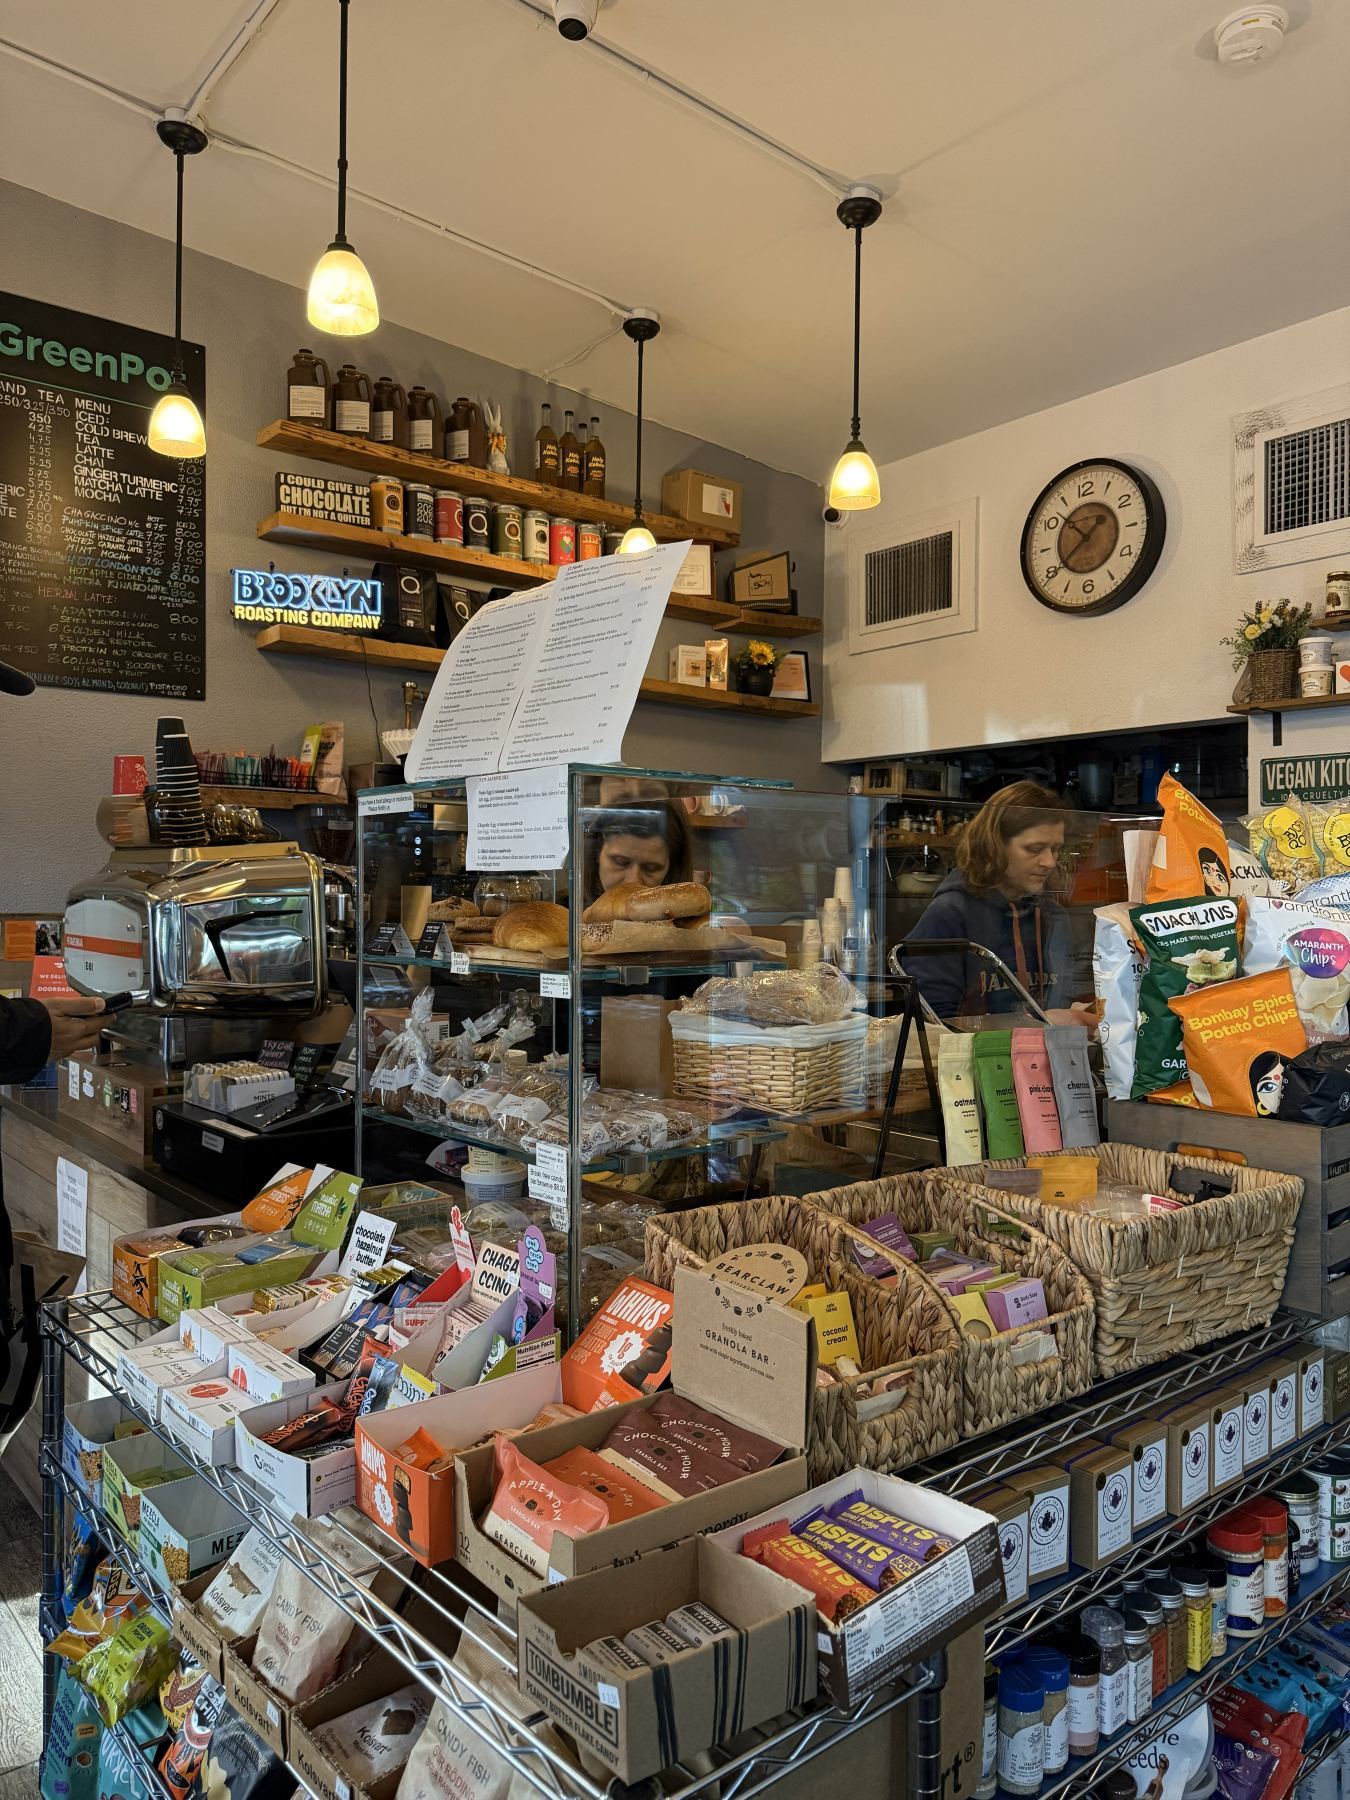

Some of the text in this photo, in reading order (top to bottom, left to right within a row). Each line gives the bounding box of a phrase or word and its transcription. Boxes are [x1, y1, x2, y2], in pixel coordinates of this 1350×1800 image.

[0, 322, 172, 392] GreenPo
[37, 389, 111, 414] TEA MENU
[75, 421, 147, 446] COLD BREW
[76, 432, 100, 446] TEA
[75, 454, 104, 468] CHAI
[76, 443, 115, 460] LATTE
[74, 465, 178, 494] GINGER TURMERIC
[74, 476, 163, 500] MATCHA LATTE
[280, 474, 370, 496] I COULD GIVE UP
[1078, 481, 1095, 498] 12
[74, 486, 120, 504] MOCHA
[280, 484, 370, 516] CHOCOLATE
[1118, 494, 1131, 508] 2
[62, 515, 98, 530] PUMPKIN
[101, 525, 124, 534] SPICE
[280, 504, 370, 526] BUT I'M NOT A QUITTER
[1044, 516, 1060, 532] 10
[66, 544, 131, 562] MINT MOCHA
[1120, 545, 1134, 557] 4
[70, 566, 88, 576] HOT
[234, 570, 382, 615] BROOKLYN
[1082, 579, 1094, 594] 6
[234, 606, 382, 630] ROASTING COMPANY
[63, 625, 110, 637] GOLDEN
[63, 644, 107, 656] PROTEIN
[63, 656, 120, 668] COLLAGEN
[1266, 760, 1316, 790] VEGAN
[1303, 790, 1344, 800] CRUELTY
[1146, 905, 1234, 934] SNACKLINS
[1170, 936, 1188, 947] MADE
[1294, 940, 1344, 952] AMARANTH
[1301, 947, 1336, 968] Chips
[1188, 992, 1294, 1031] Bombay Spice
[1200, 1008, 1298, 1043] Potato Chips
[263, 1040, 277, 1049] TRY
[253, 1094, 276, 1102] MINTS
[1029, 1086, 1042, 1095] pink
[355, 1225, 386, 1244] chocolate
[355, 1238, 383, 1257] hazelnut
[356, 1250, 376, 1268] butter
[482, 1248, 520, 1274] CHAGA
[716, 1262, 790, 1295] BEARCLAW
[606, 1286, 670, 1330] WHIMS
[822, 1325, 849, 1337] coconut
[826, 1335, 848, 1346] cream
[517, 1340, 555, 1355] Nutrition Facts
[706, 1330, 769, 1364] GRANOLA BAR
[662, 1419, 732, 1458] CHOCOLATE HOUR
[360, 1432, 386, 1482] WHIMS
[624, 1432, 692, 1480] CHOCOLATE HOUR
[508, 1479, 563, 1522] APPLE A DAY
[142, 1500, 160, 1528] MEZCLA
[858, 1516, 880, 1530] Fudge
[459, 1531, 470, 1554] 12
[494, 1530, 537, 1568] BEARCLAW
[812, 1536, 834, 1550] Fudge
[897, 1554, 920, 1570] NEW
[208, 1586, 236, 1616] Kolsvart
[276, 1594, 324, 1636] CANDY FISH
[179, 1622, 210, 1663] Kolsvart
[871, 1644, 885, 1659] 190
[529, 1648, 614, 1736] TOMBUMBLE
[234, 1684, 271, 1734] Kolsvart
[526, 1680, 620, 1767] PEANUT BUTTER FLAKE CANDY
[357, 1726, 389, 1755] Kolsvart
[437, 1718, 492, 1788] CANDY FISH
